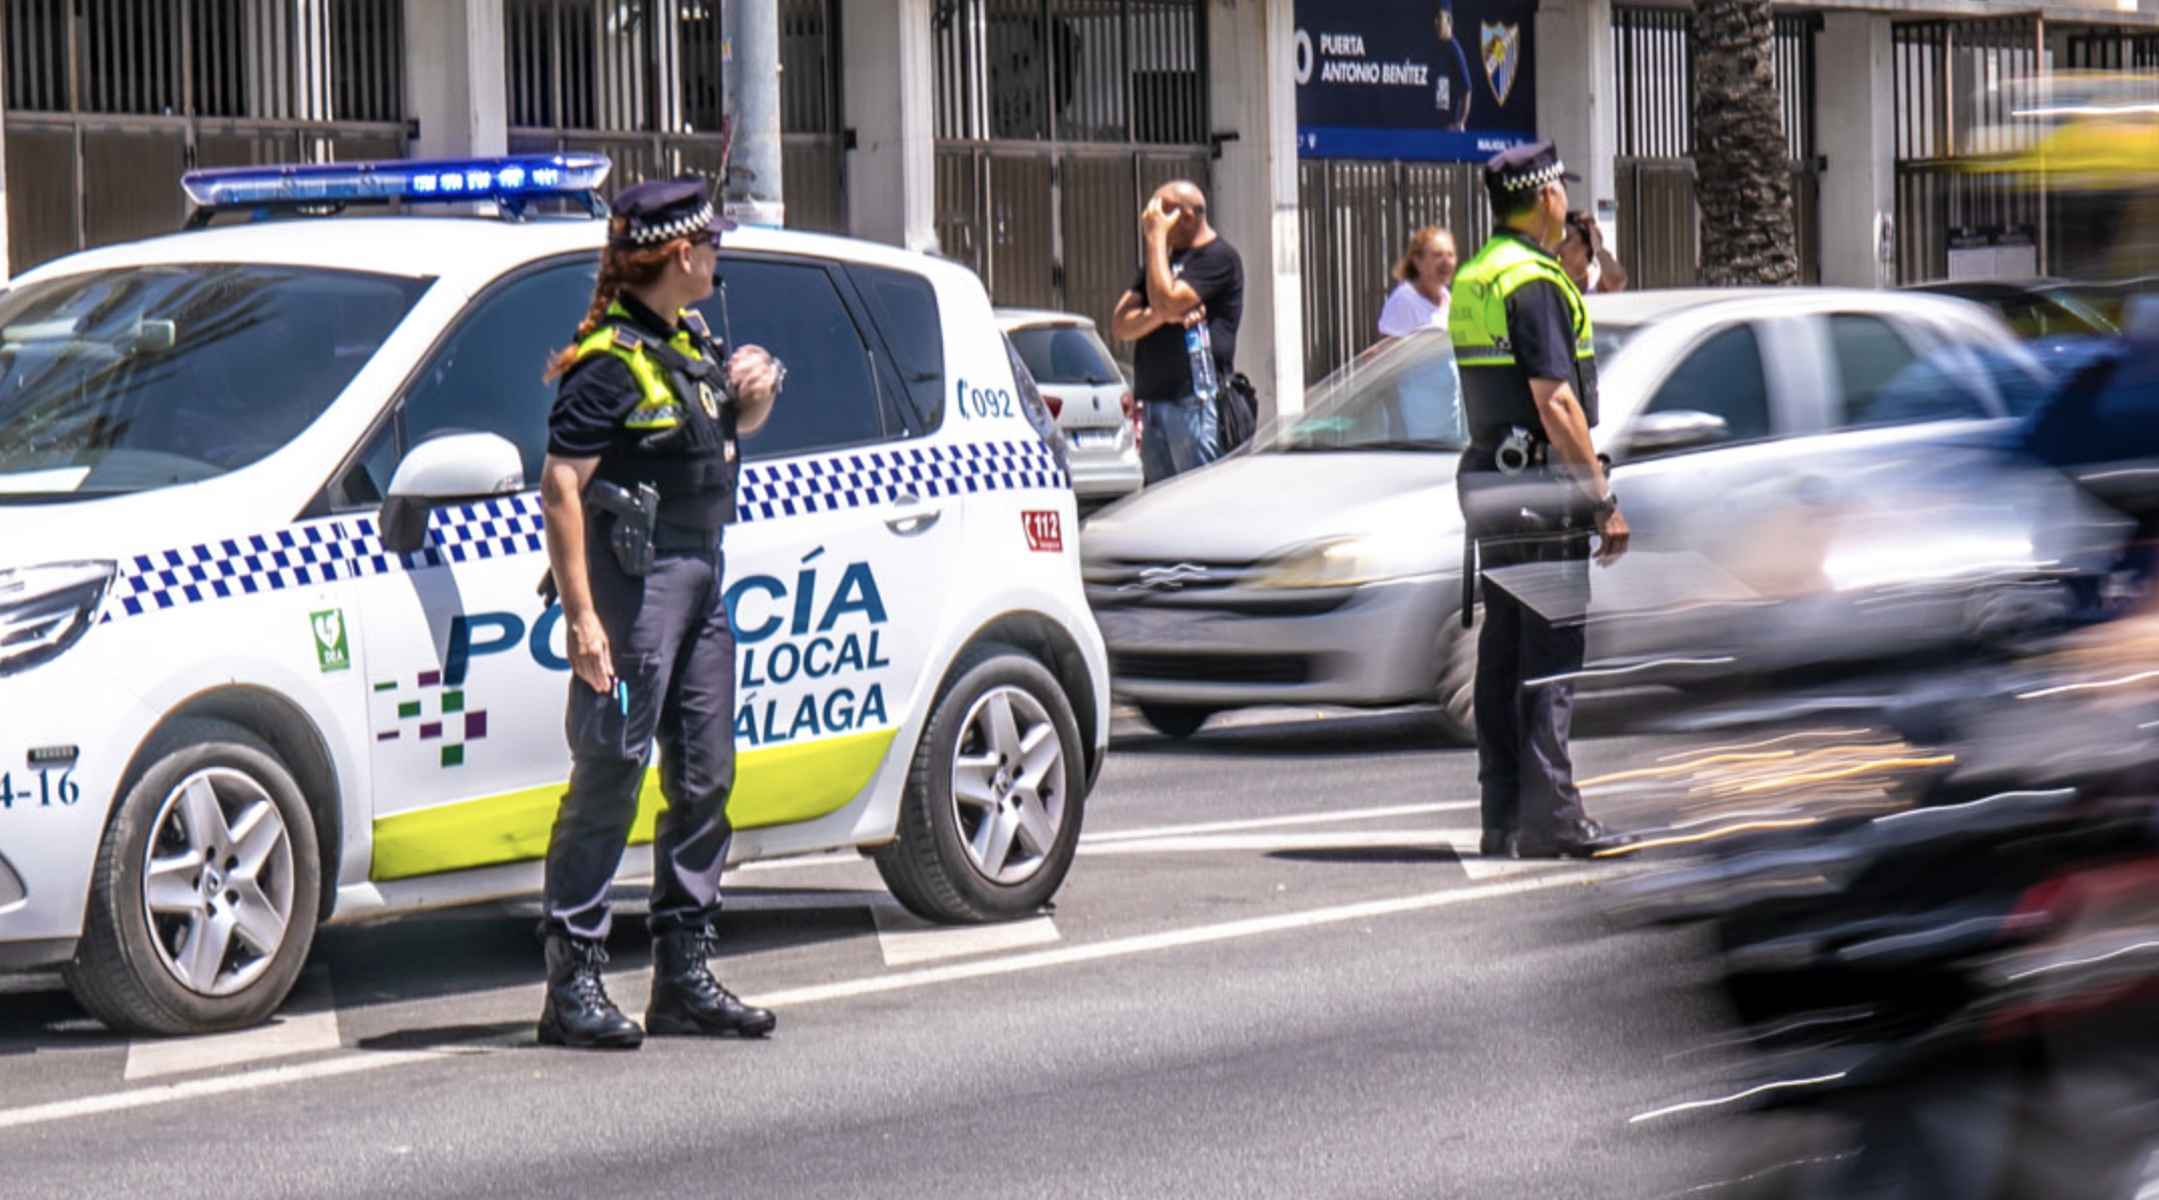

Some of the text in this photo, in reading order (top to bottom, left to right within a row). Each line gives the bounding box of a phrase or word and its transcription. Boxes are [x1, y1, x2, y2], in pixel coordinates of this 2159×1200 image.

[1320, 33, 1366, 56] PUERTA
[1321, 58, 1429, 86] ANTONIO BENÍTEZ
[970, 387, 1014, 418] 092
[1033, 512, 1058, 539] 112
[442, 545, 888, 687] PCÍA
[741, 629, 890, 689] LOCAL
[732, 683, 888, 746] ÁLAGA
